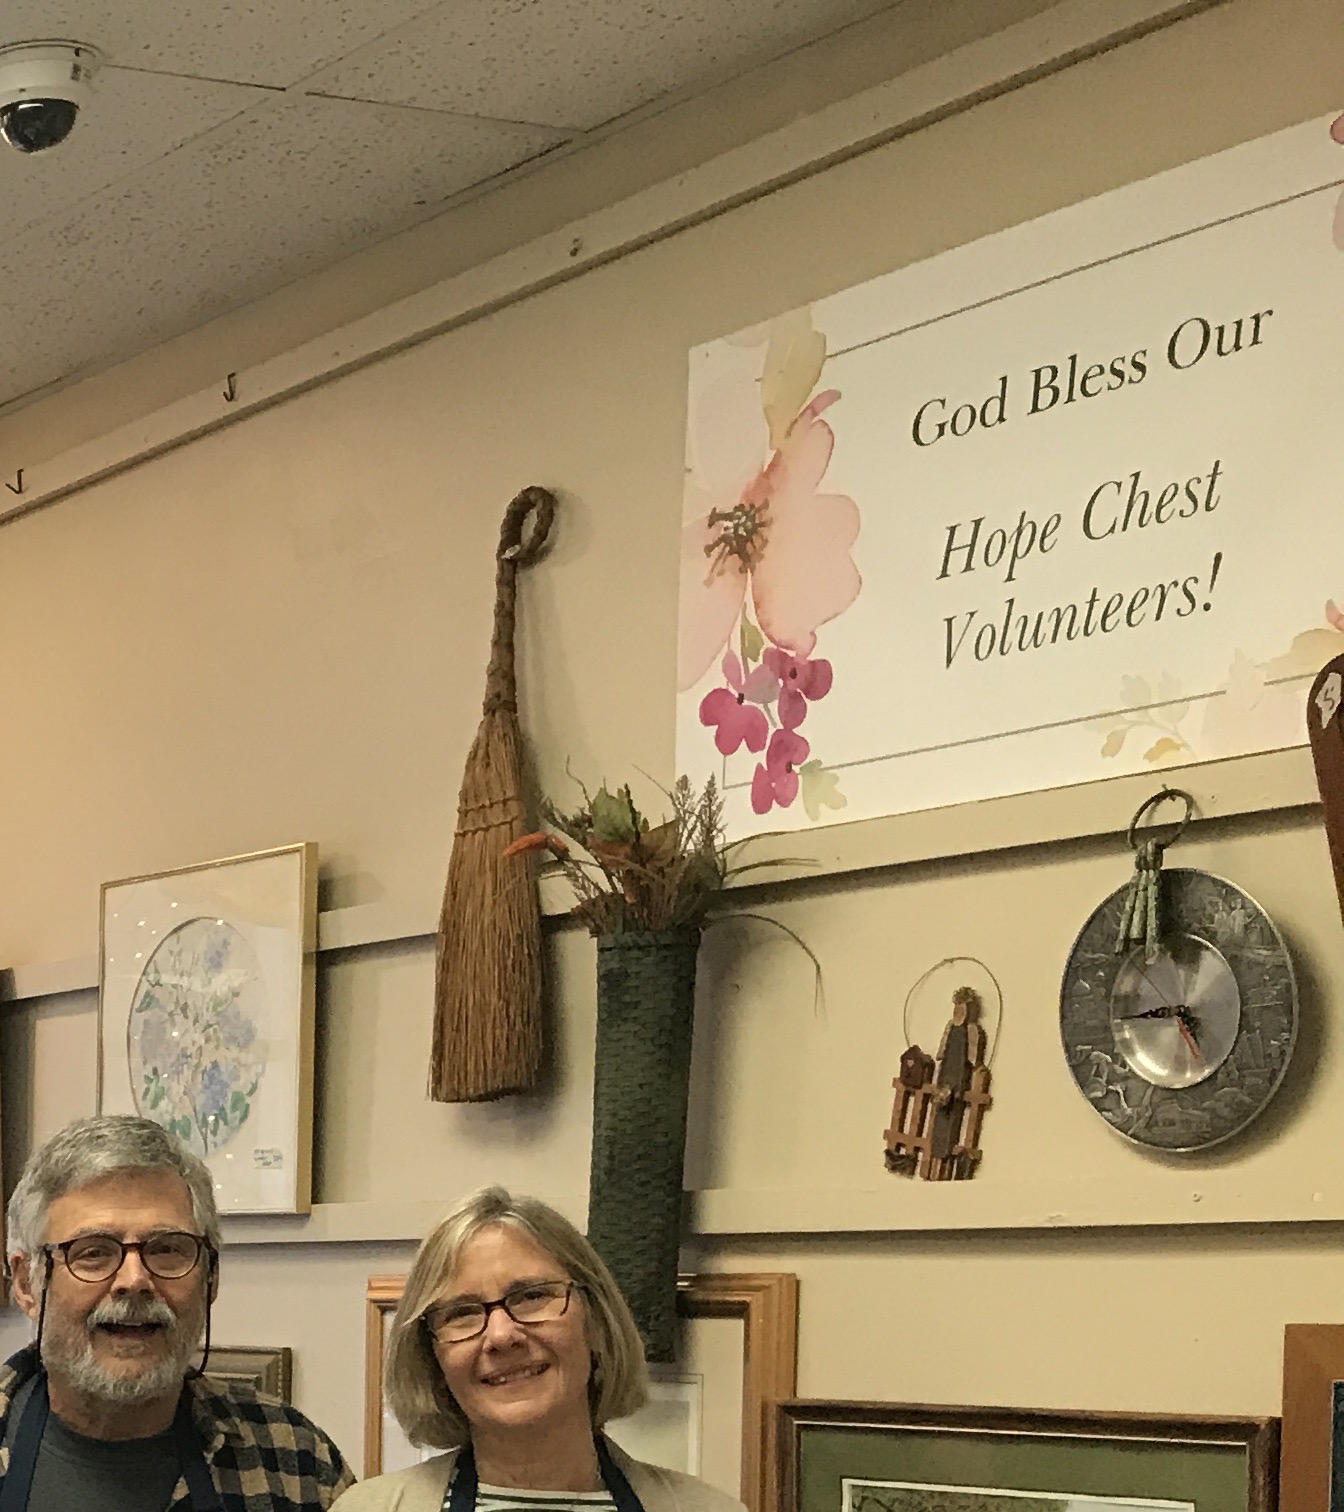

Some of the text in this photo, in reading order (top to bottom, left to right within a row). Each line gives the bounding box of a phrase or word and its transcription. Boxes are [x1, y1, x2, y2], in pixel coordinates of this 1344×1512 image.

[910, 308, 1274, 449] God Bless Our
[935, 458, 1224, 583] Hope Chest
[942, 552, 1224, 671] Volunteers!
